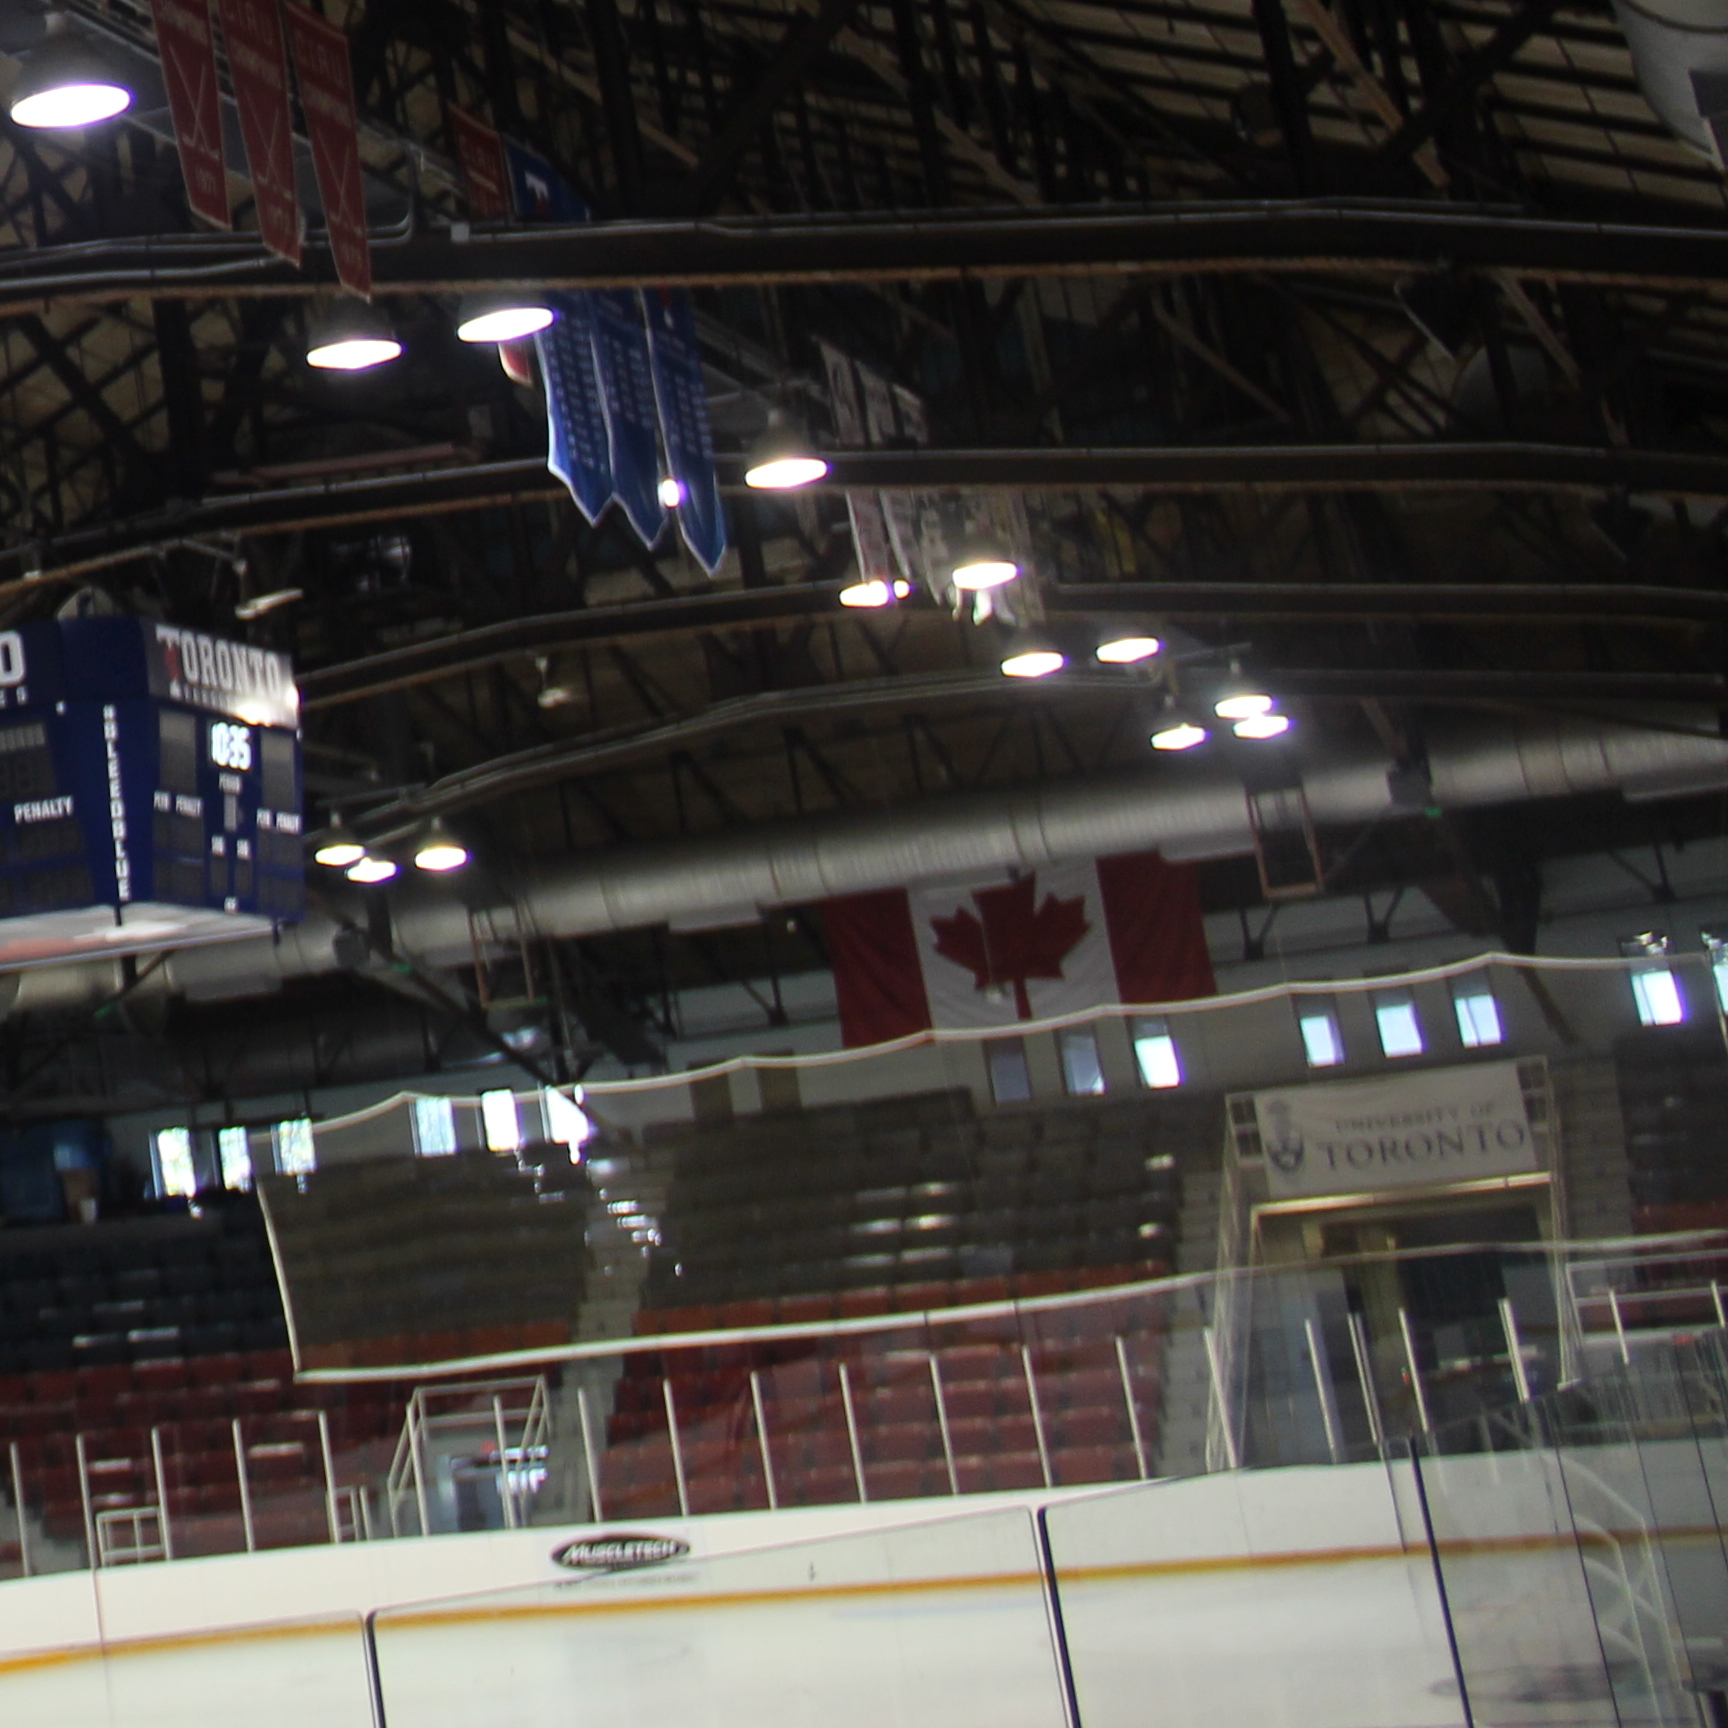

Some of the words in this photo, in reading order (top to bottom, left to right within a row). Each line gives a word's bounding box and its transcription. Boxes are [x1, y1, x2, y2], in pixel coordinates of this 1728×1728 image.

[14, 795, 74, 824] PENALTY
[1334, 1106, 1459, 1132] UNIVERSITY
[1315, 1120, 1525, 1170] TORONTO
[559, 1538, 678, 1567] MUSCLETECH
